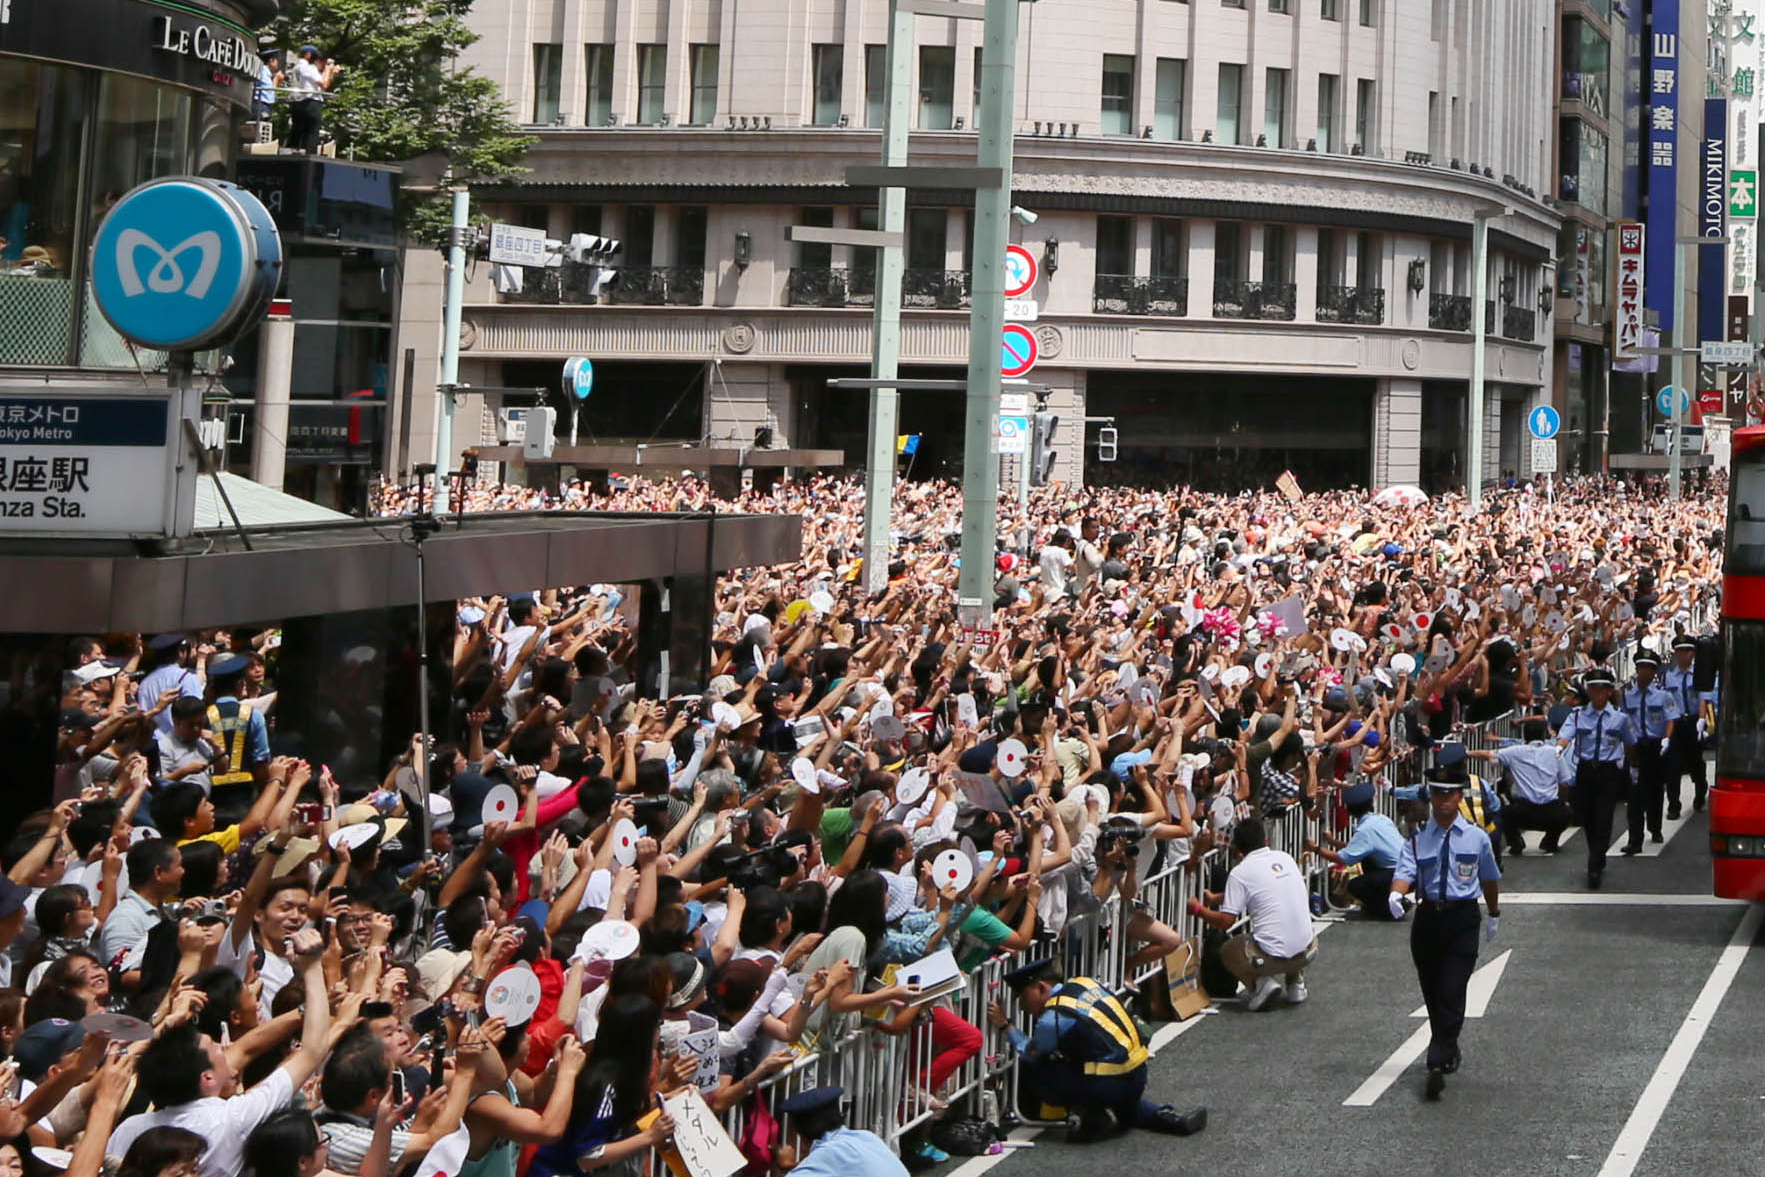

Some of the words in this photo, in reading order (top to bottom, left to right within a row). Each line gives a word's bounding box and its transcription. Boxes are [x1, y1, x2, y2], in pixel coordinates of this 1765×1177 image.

[163, 16, 190, 54] LE
[1652, 33, 1678, 167] 山野楽器
[1731, 178, 1754, 210] 本
[1621, 259, 1640, 351] キムラヤのパン
[34, 427, 72, 439] Metro
[42, 496, 86, 518] Sta.
